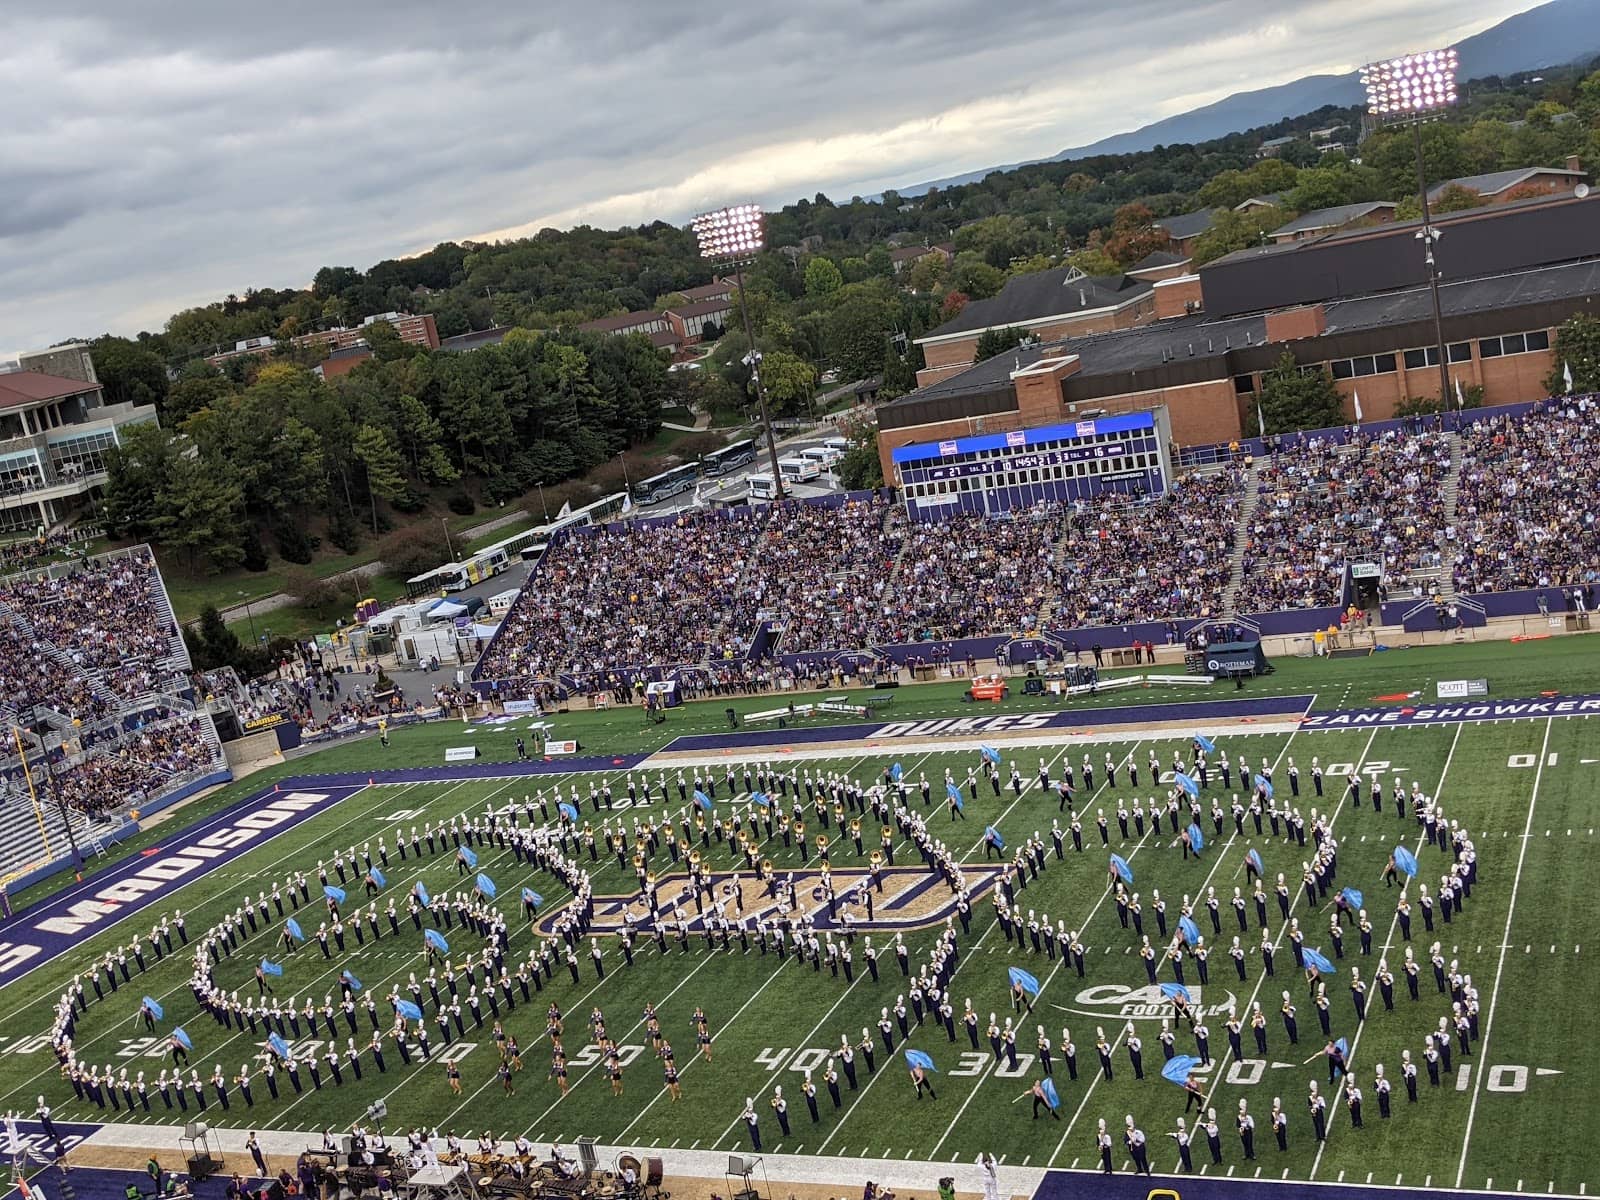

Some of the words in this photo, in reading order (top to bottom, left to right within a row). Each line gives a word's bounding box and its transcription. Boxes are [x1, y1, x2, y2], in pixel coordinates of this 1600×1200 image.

[949, 466, 961, 477] 27
[1094, 446, 1104, 457] 16
[1152, 468, 1159, 476] 5
[864, 712, 1059, 739] DUKES
[1302, 712, 1402, 726] ZANE
[1412, 700, 1600, 720] SHOWKER
[34, 792, 331, 935] MADISON
[1075, 984, 1202, 1005] CAA
[567, 1044, 646, 1067] 50
[753, 1047, 831, 1073] 40
[947, 1051, 1035, 1078] 30
[1455, 1063, 1528, 1092] 10
